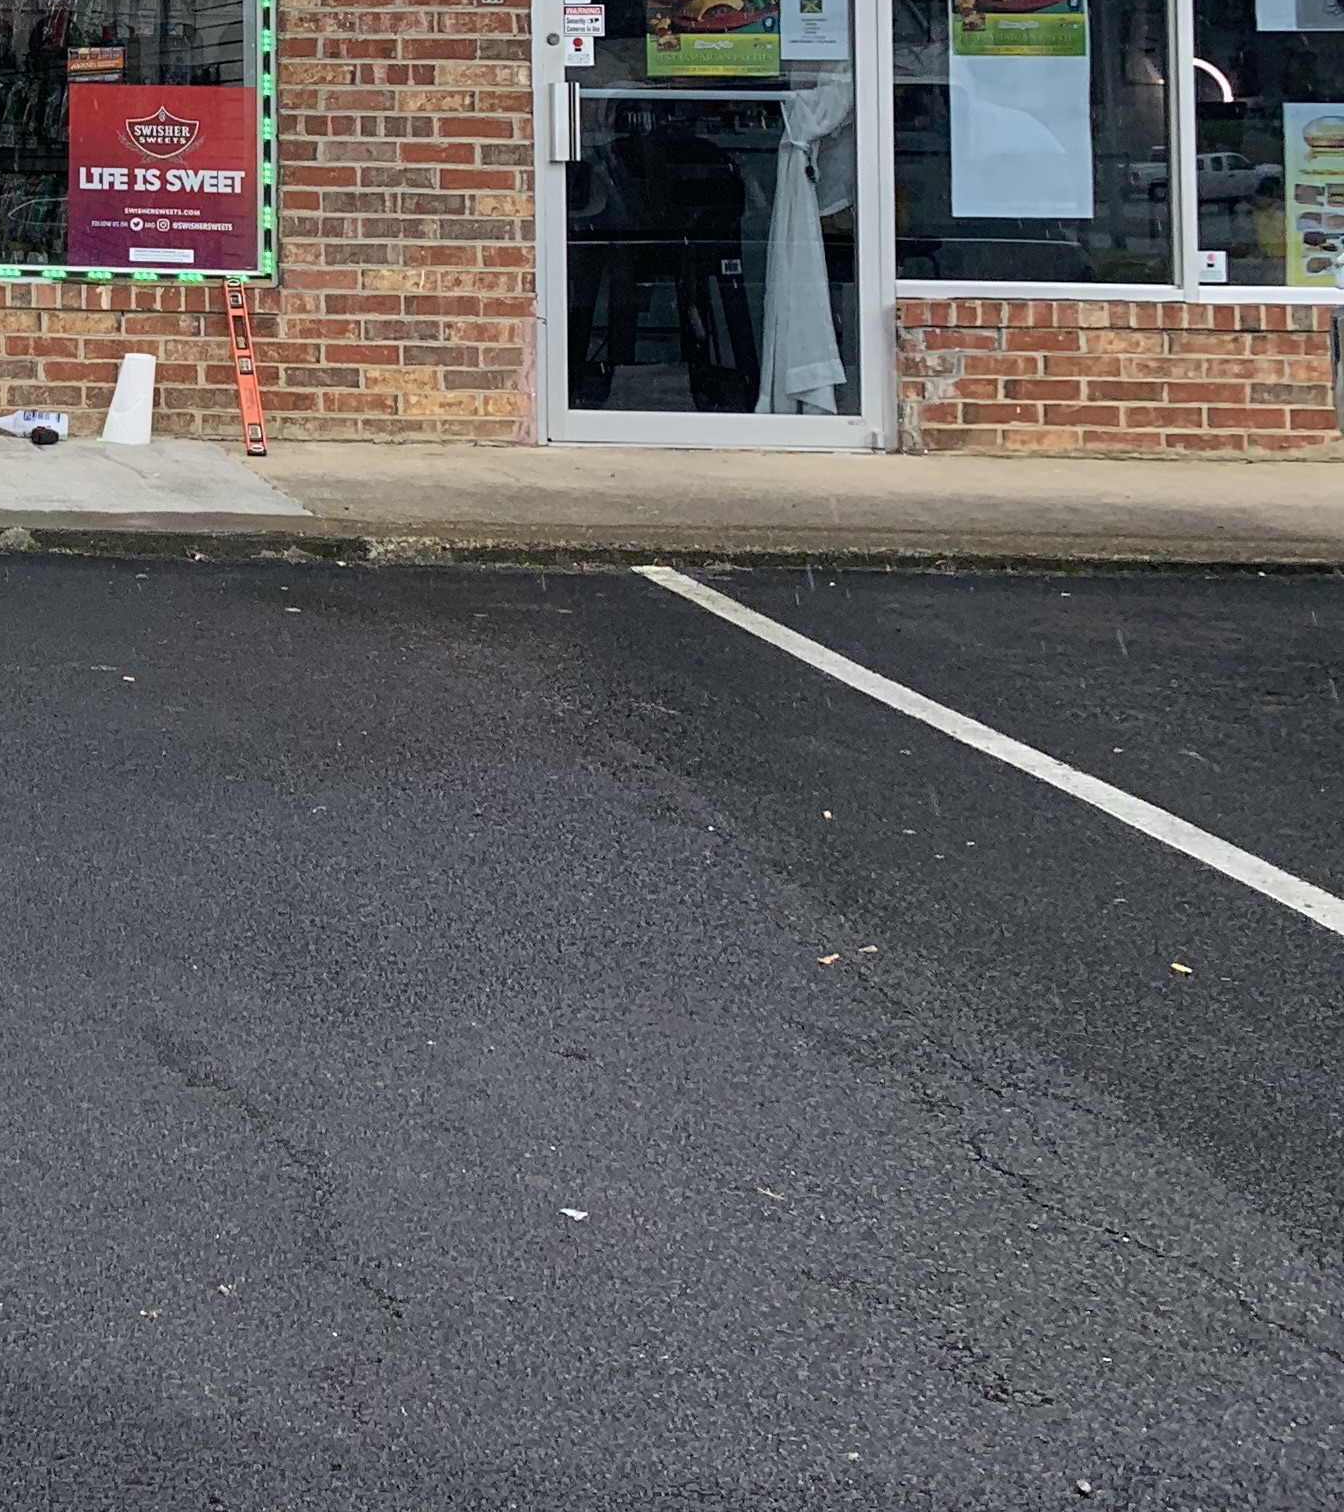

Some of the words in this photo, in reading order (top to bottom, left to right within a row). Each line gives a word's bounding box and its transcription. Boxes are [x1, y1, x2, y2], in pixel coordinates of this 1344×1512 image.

[565, 7, 602, 15] WARNING
[134, 124, 191, 137] SWISHER
[138, 136, 187, 145] SWEETS
[79, 166, 129, 191] LIFE
[133, 168, 161, 192] IS
[165, 169, 246, 194] SWEET
[124, 207, 201, 217] SWISHERSWEETS.COM
